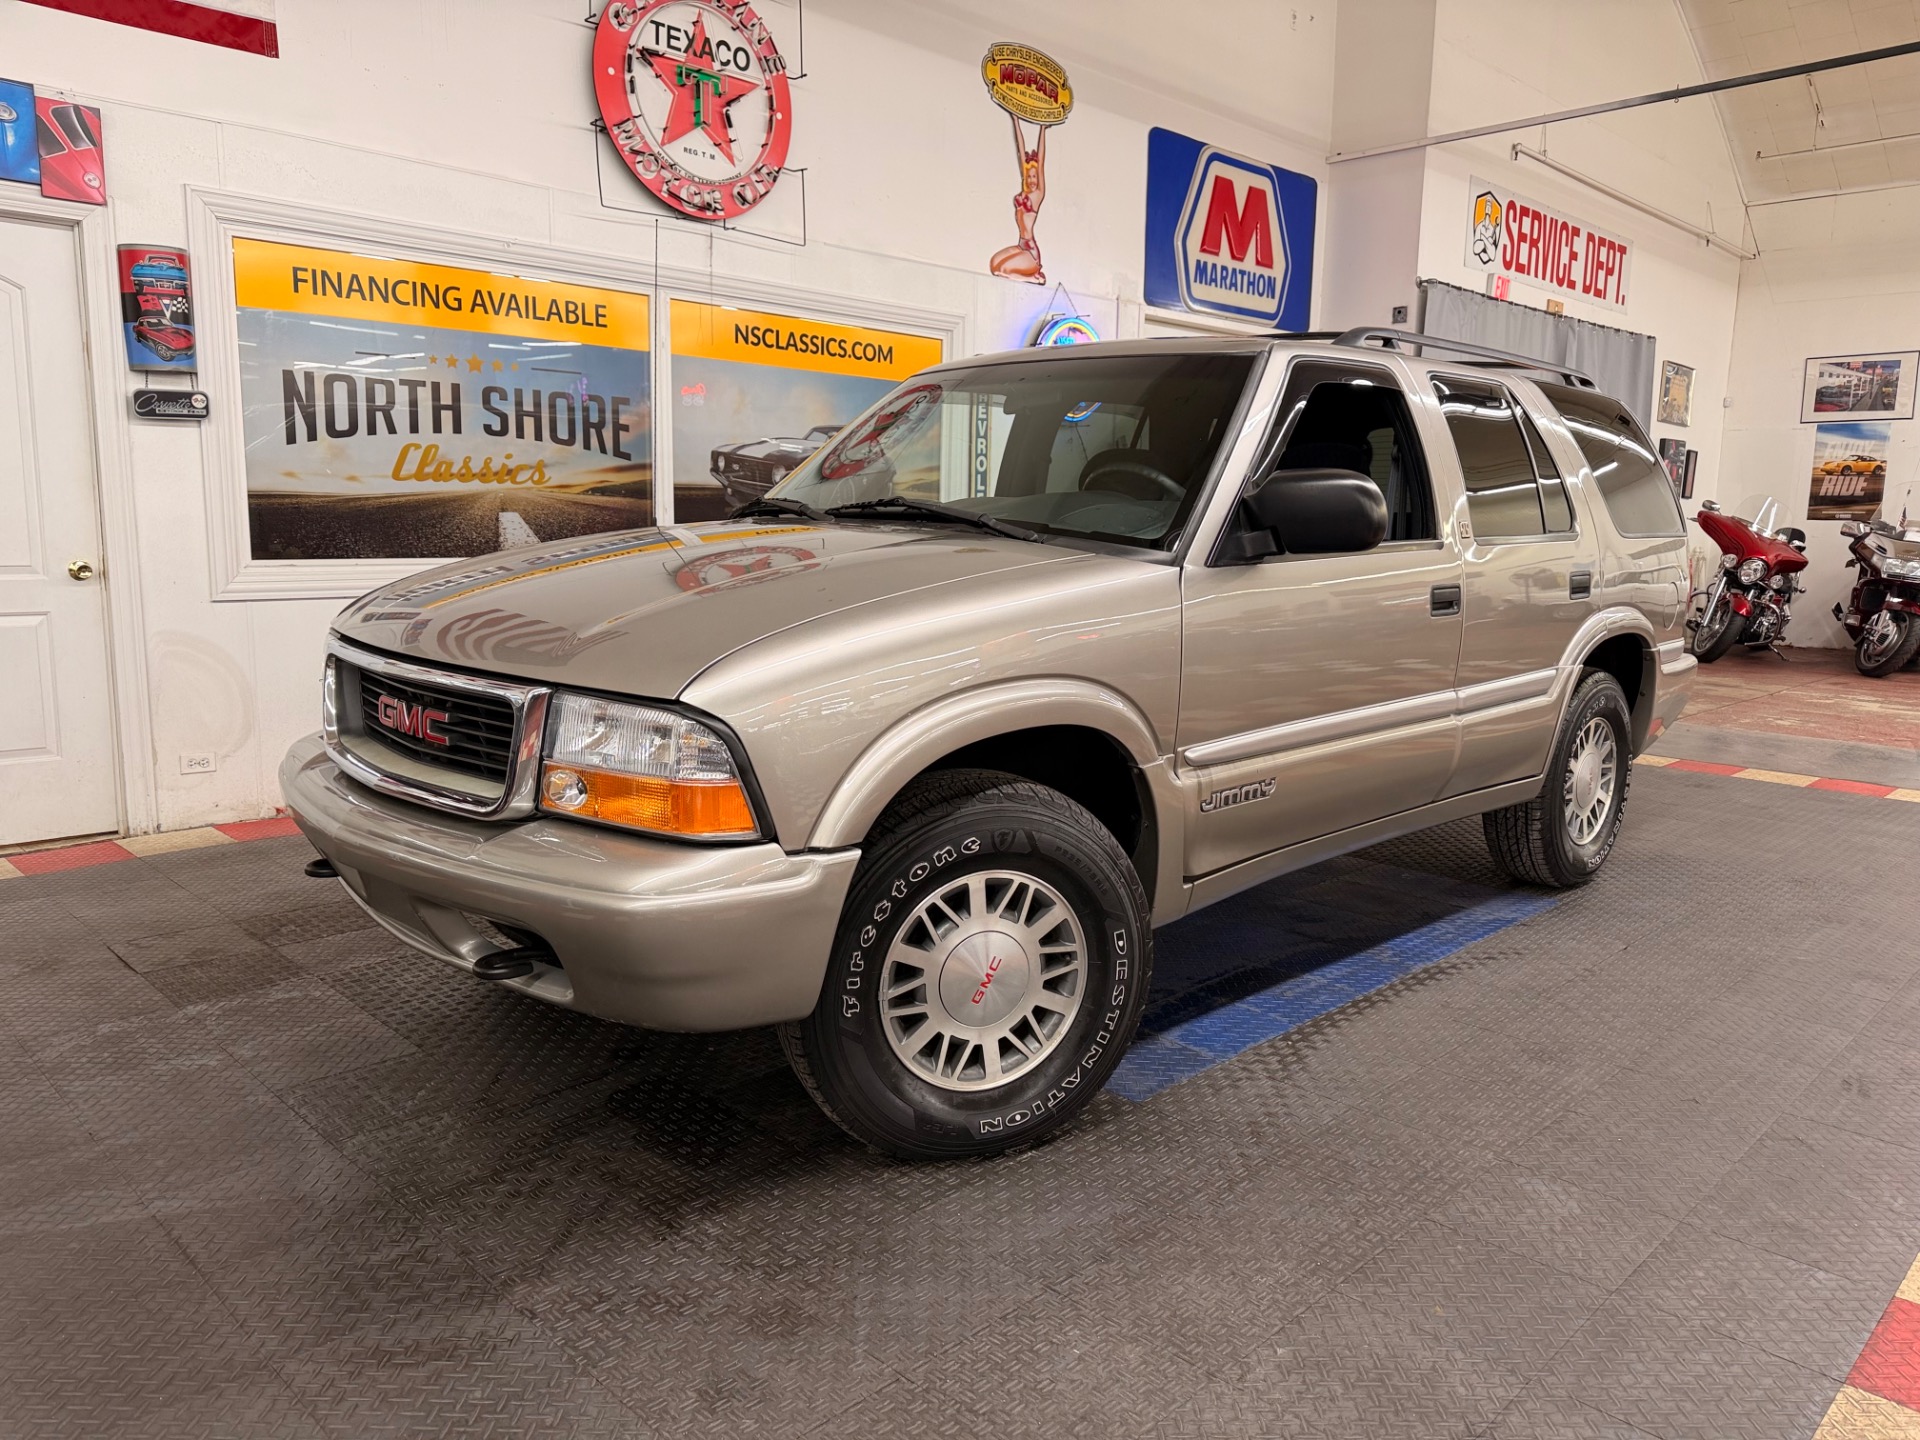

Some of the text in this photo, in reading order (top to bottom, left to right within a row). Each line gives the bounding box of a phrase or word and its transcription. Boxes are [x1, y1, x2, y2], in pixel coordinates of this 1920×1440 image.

[650, 20, 750, 71] TEXACO
[994, 47, 1005, 57] USE
[1005, 47, 1033, 61] CHRYSLER
[1000, 63, 1059, 104] MOPAR
[1019, 89, 1027, 98] AND
[1028, 92, 1054, 106] ACCESSORIES
[612, 118, 725, 215] MOTOR
[656, 151, 673, 167] MAD
[732, 163, 782, 209] OIL
[1199, 175, 1274, 270] M
[1502, 199, 1628, 306] SERVICE DEPT.
[291, 266, 608, 329] FINANCING AVAILABLE
[1193, 259, 1276, 299] MARATHON
[734, 323, 893, 364] NSCLASSICS.COM
[135, 393, 193, 412] Corvette
[281, 368, 632, 462] NORTH SHORE
[390, 442, 552, 486] Classics
[1819, 475, 1869, 497] RIDE
[378, 694, 452, 746] GMC
[970, 955, 1003, 1006] GMC
[979, 929, 1129, 1136] DESTINATION
